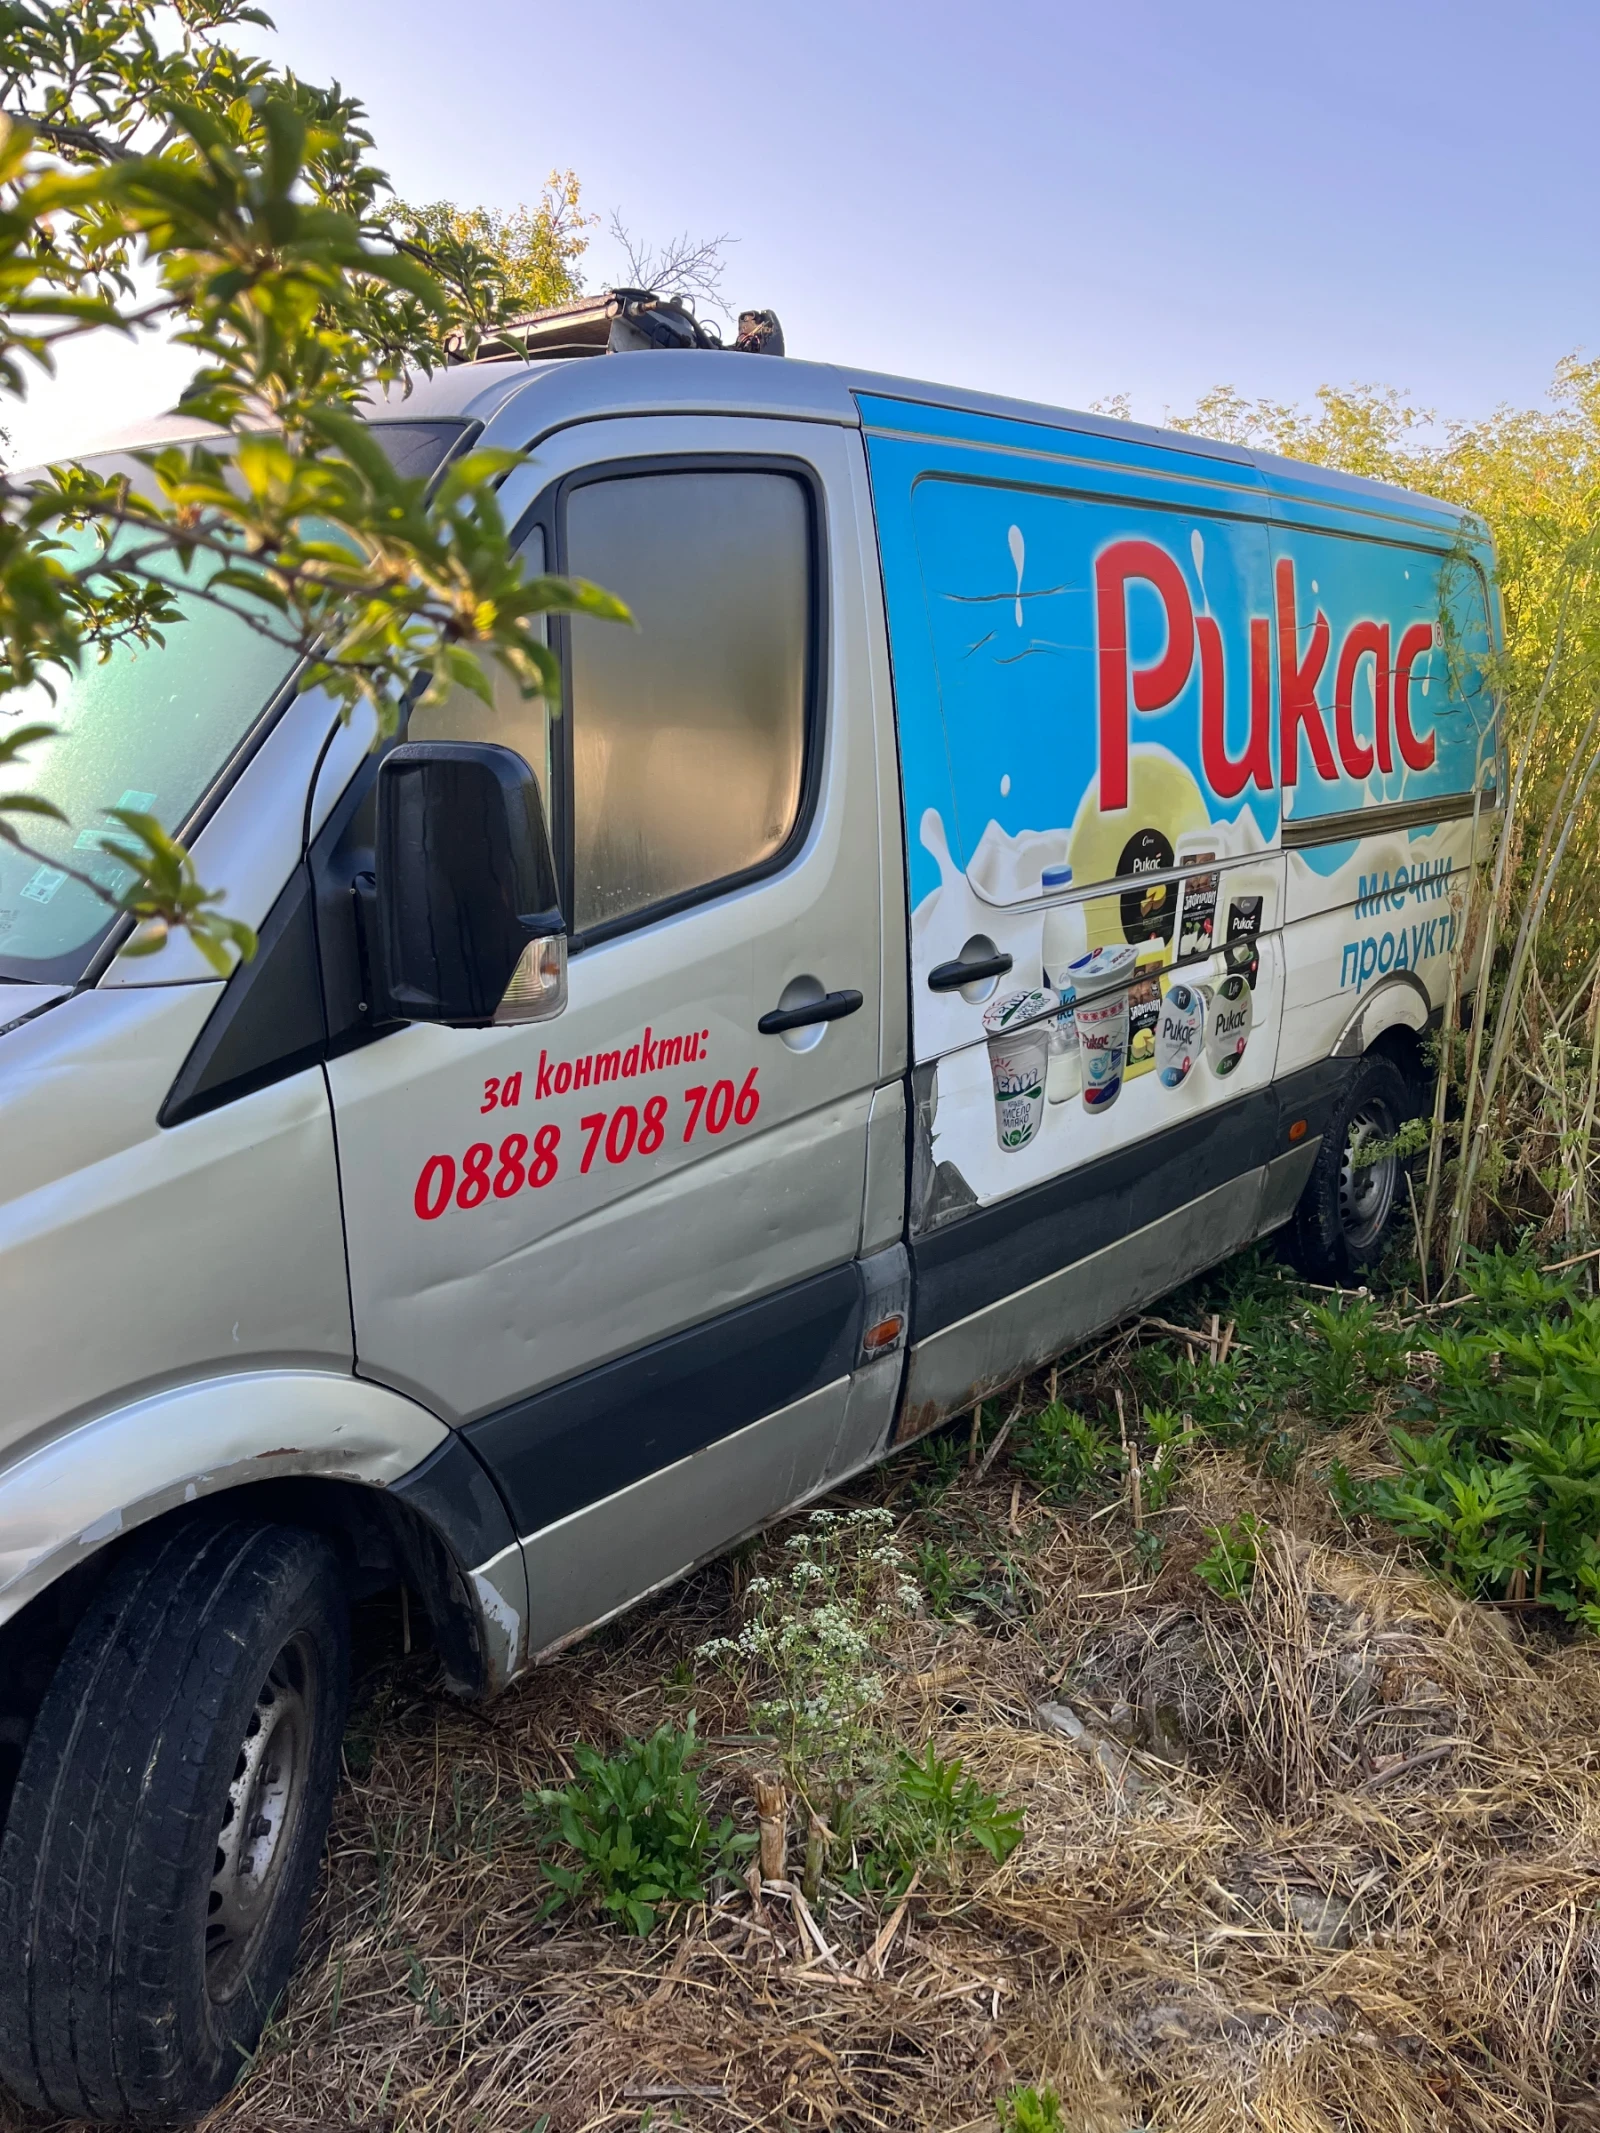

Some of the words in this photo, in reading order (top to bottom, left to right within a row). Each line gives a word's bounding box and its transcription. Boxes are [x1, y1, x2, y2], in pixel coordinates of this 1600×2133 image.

[1094, 541, 1436, 811] Рикас
[1233, 916, 1254, 930] Рикас
[1215, 1009, 1248, 1036] Рикас
[480, 1071, 522, 1114] за
[535, 1027, 709, 1100] контакти:
[414, 1124, 561, 1220] 0888
[580, 1095, 667, 1173] 708
[683, 1067, 760, 1143] 706
